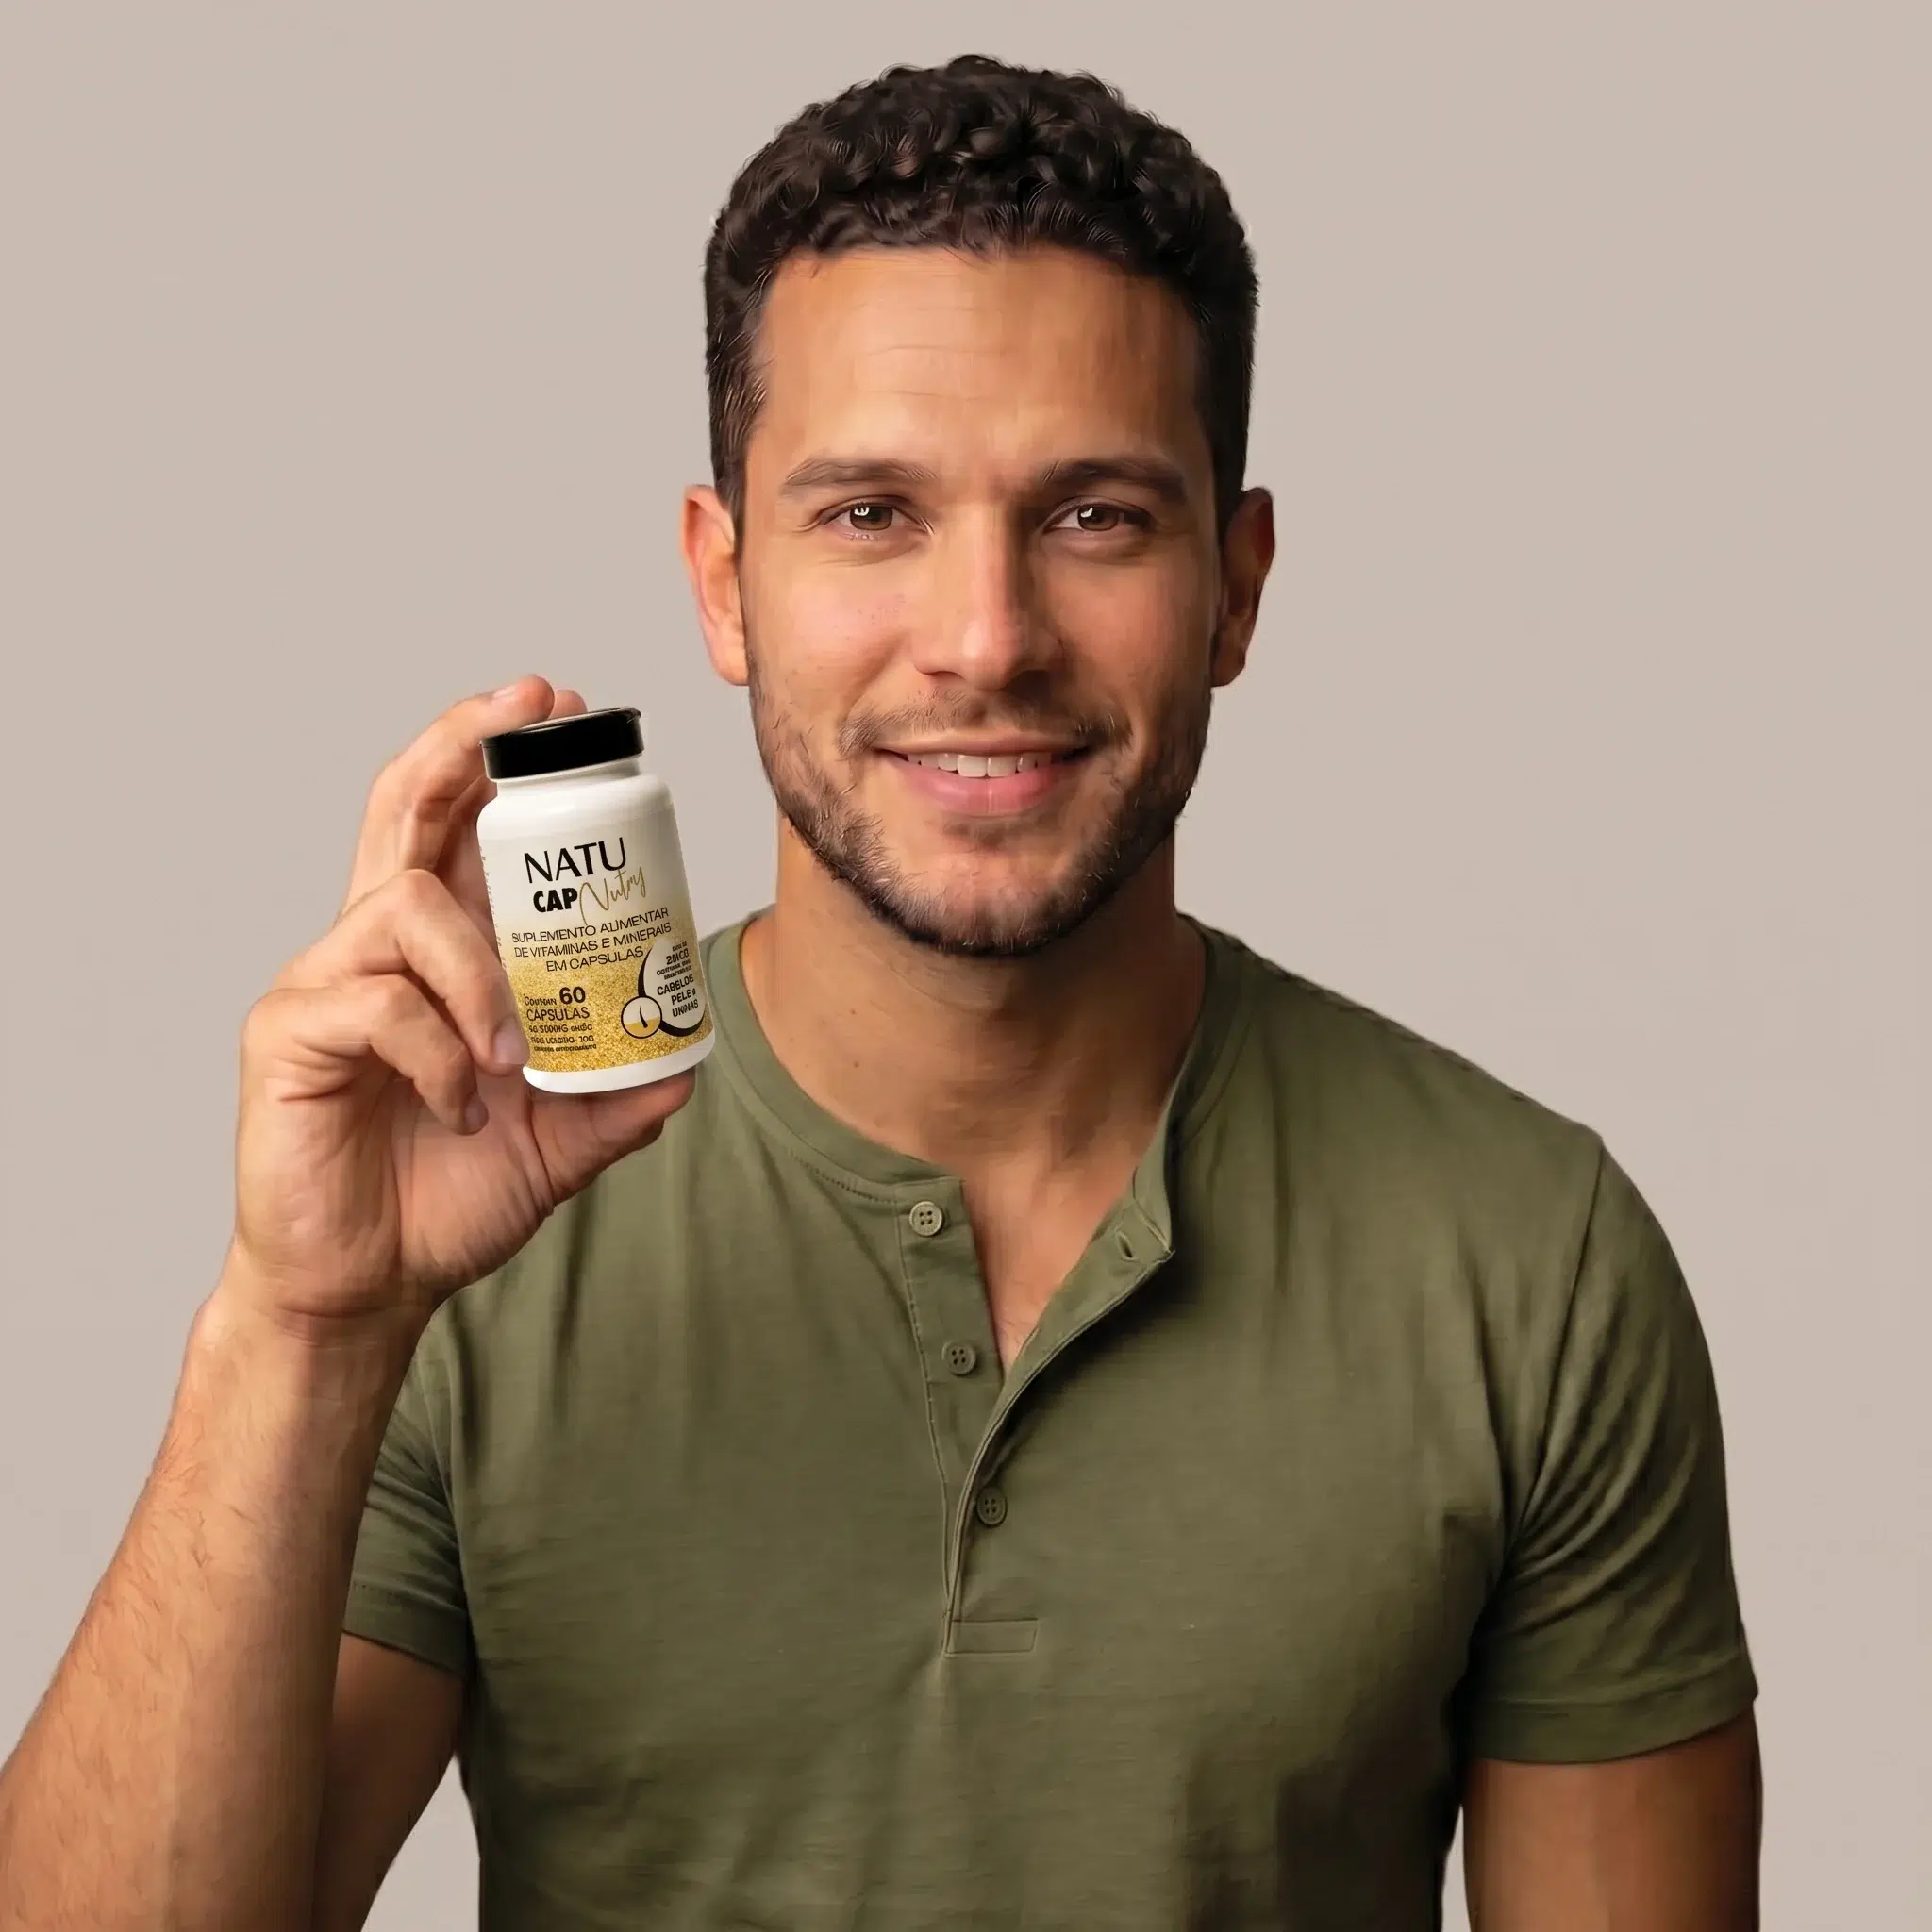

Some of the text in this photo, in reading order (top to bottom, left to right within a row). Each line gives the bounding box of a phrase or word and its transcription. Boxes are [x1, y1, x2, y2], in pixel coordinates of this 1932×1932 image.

[524, 837, 626, 884] NATU
[533, 887, 577, 913] CAP
[514, 945, 528, 958] DE
[602, 937, 610, 949] E
[545, 959, 568, 973] EM
[569, 945, 644, 971] CAPSULAS
[559, 986, 586, 1006] 60
[671, 989, 691, 1006] PELE
